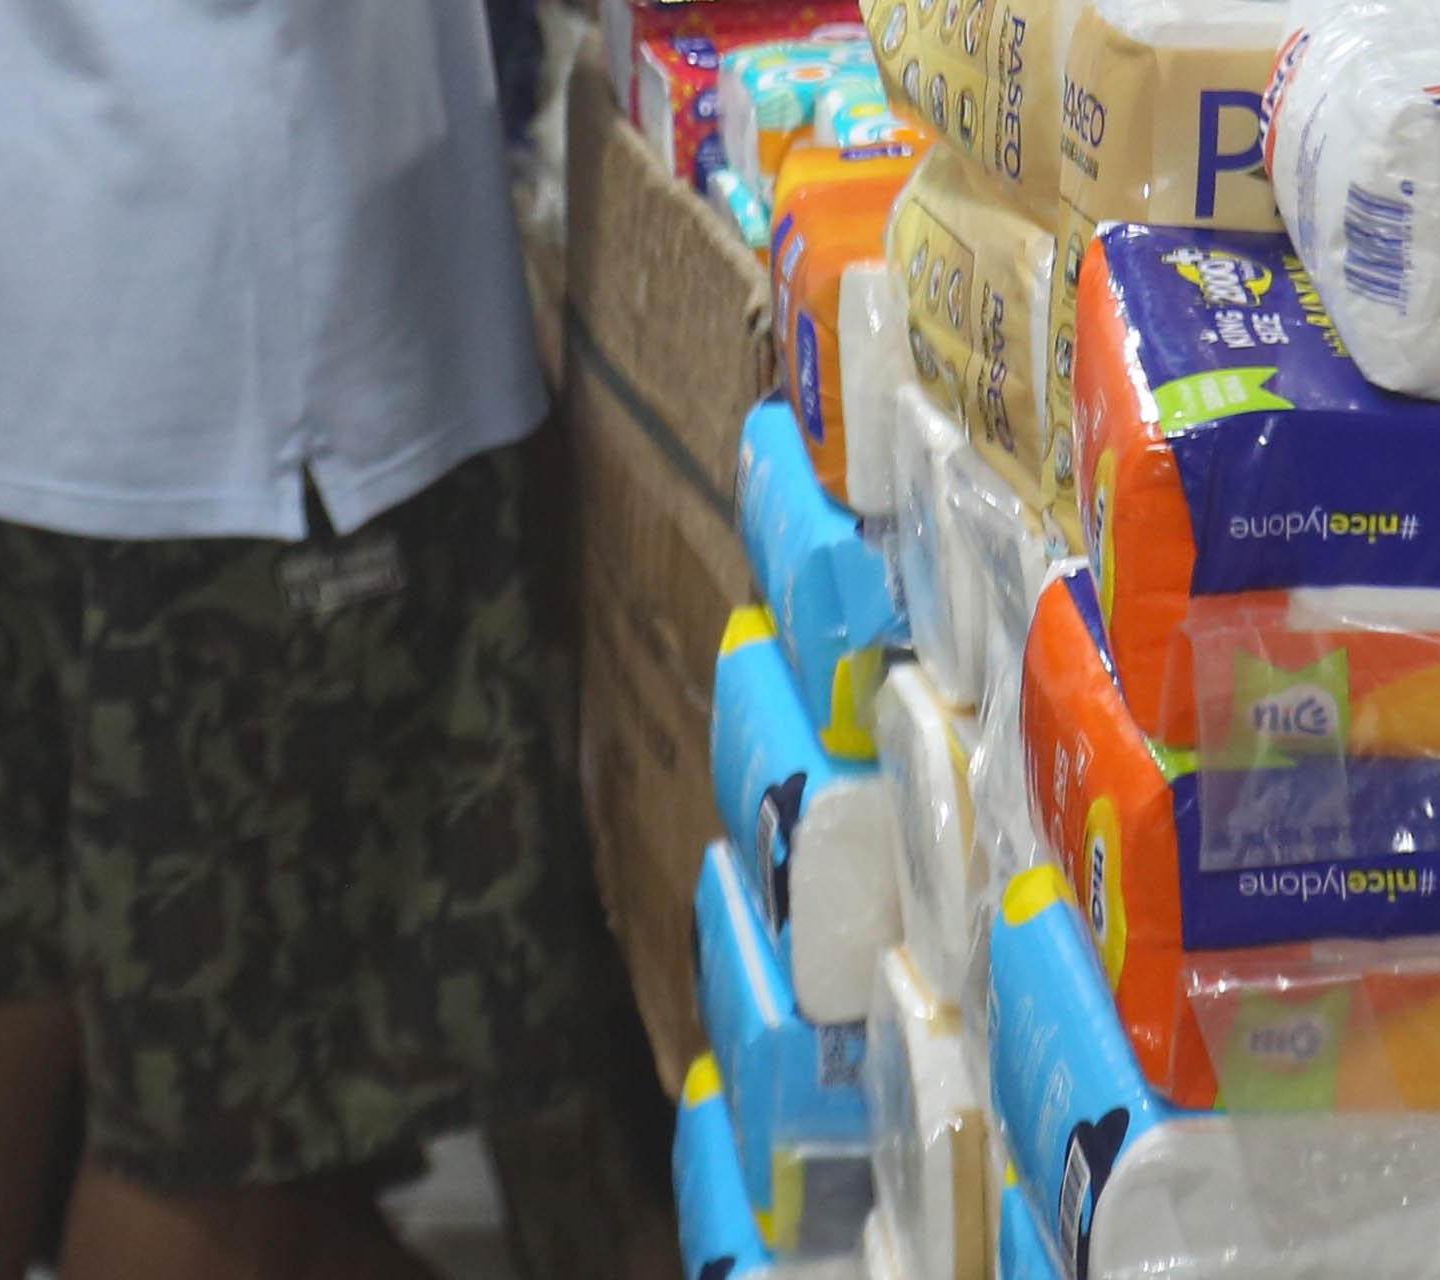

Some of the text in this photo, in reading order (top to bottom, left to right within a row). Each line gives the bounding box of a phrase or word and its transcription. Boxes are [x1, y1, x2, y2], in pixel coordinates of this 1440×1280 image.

[1003, 15, 1027, 180] PASEO
[1214, 309, 1257, 349] KING
[1252, 311, 1290, 345] SIZE
[1229, 505, 1420, 544] #nicelydone
[1239, 865, 1437, 903] #nicelydone
